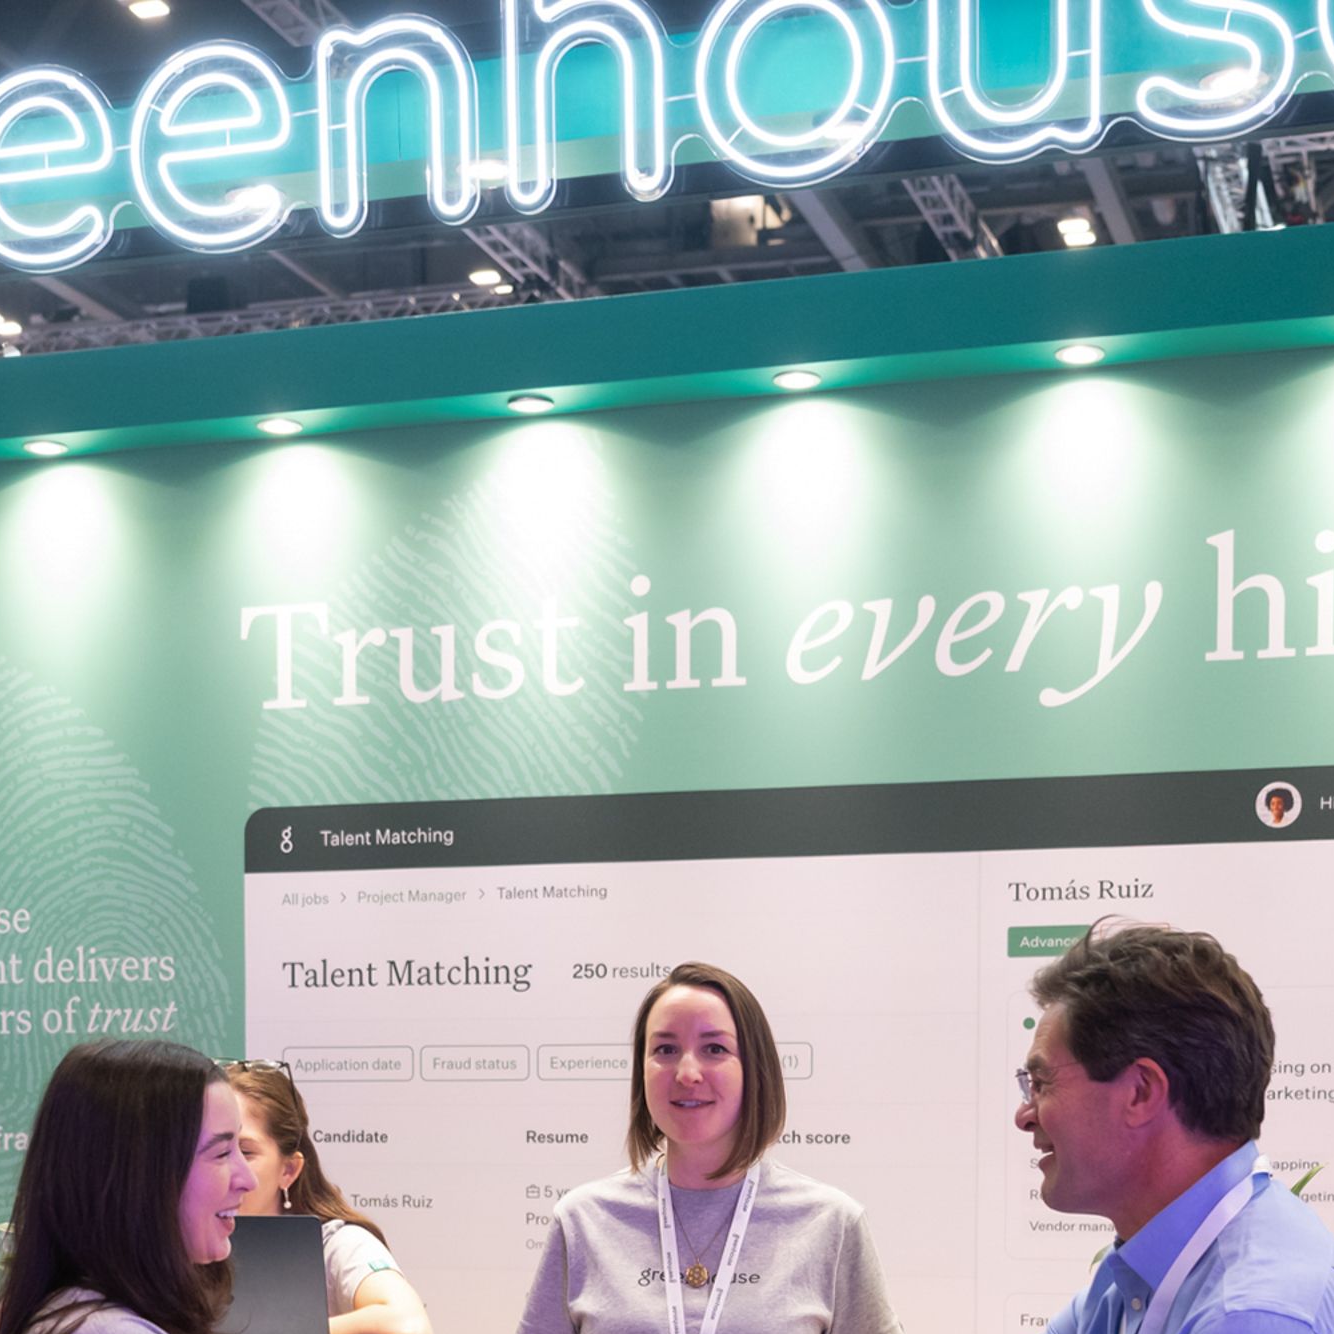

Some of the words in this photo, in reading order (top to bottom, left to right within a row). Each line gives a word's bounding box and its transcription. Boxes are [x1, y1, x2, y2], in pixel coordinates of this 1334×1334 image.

[240, 597, 585, 710] Trust
[623, 575, 747, 691] in
[786, 580, 1164, 707] every
[320, 829, 371, 847] Talent
[375, 827, 455, 847] Matching
[357, 890, 404, 906] Project
[407, 888, 467, 904] Manager
[497, 886, 538, 900] Talent
[542, 884, 608, 901] Matching
[1008, 878, 1090, 903] Tomás
[1099, 877, 1155, 900] Ruiz
[281, 892, 299, 905] All
[301, 891, 329, 908] jobs
[34, 946, 175, 983] delivers
[572, 963, 608, 980] 250
[612, 962, 672, 980] results
[282, 959, 378, 989] Talent
[387, 955, 532, 992] Matching
[43, 997, 81, 1033] of
[87, 1000, 178, 1033] trust
[294, 1057, 369, 1074] Application
[372, 1057, 402, 1071] date
[433, 1057, 472, 1071] Fraud
[475, 1057, 517, 1071] status
[550, 1056, 628, 1073] Experience
[1271, 1060, 1305, 1076] sing
[1310, 1063, 1332, 1073] on
[313, 1129, 388, 1144] Candidate
[526, 1130, 589, 1144] Resume
[805, 1133, 851, 1144] score
[544, 1185, 554, 1198] 5
[351, 1193, 398, 1208] Tomás
[402, 1194, 434, 1208] Ruiz
[1029, 1220, 1075, 1232] Vendor
[1078, 1221, 1115, 1232] mana
